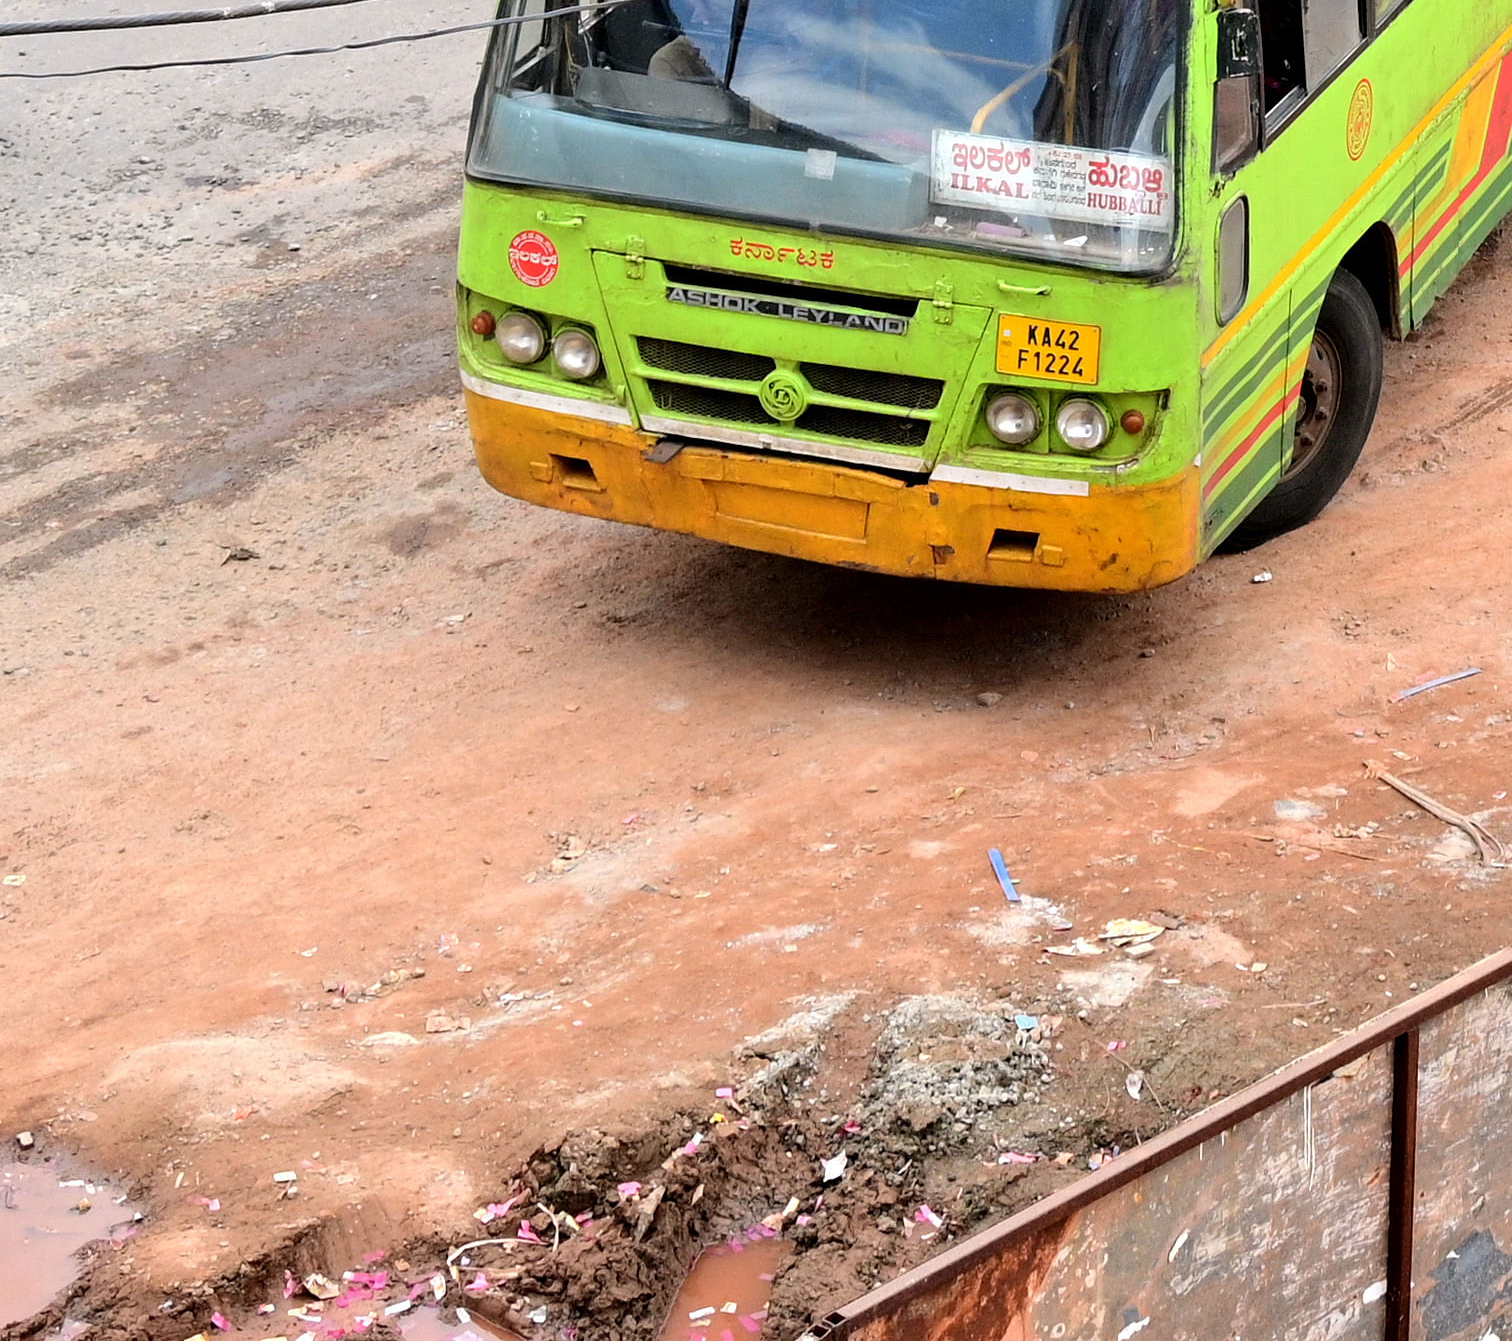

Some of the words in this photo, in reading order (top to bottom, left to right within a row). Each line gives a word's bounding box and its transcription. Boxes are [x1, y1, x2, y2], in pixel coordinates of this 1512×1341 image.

[952, 141, 1031, 174] ಇಲಕಲ್
[951, 173, 1029, 199] ILKAL
[1087, 192, 1164, 215] HUBBALLI
[730, 237, 835, 270] ಕರ್ನಾಟಕ
[668, 287, 761, 314] ASHOK
[781, 306, 907, 335] LEYLAND
[1028, 325, 1080, 351] KA42
[1018, 349, 1084, 378] F1224
